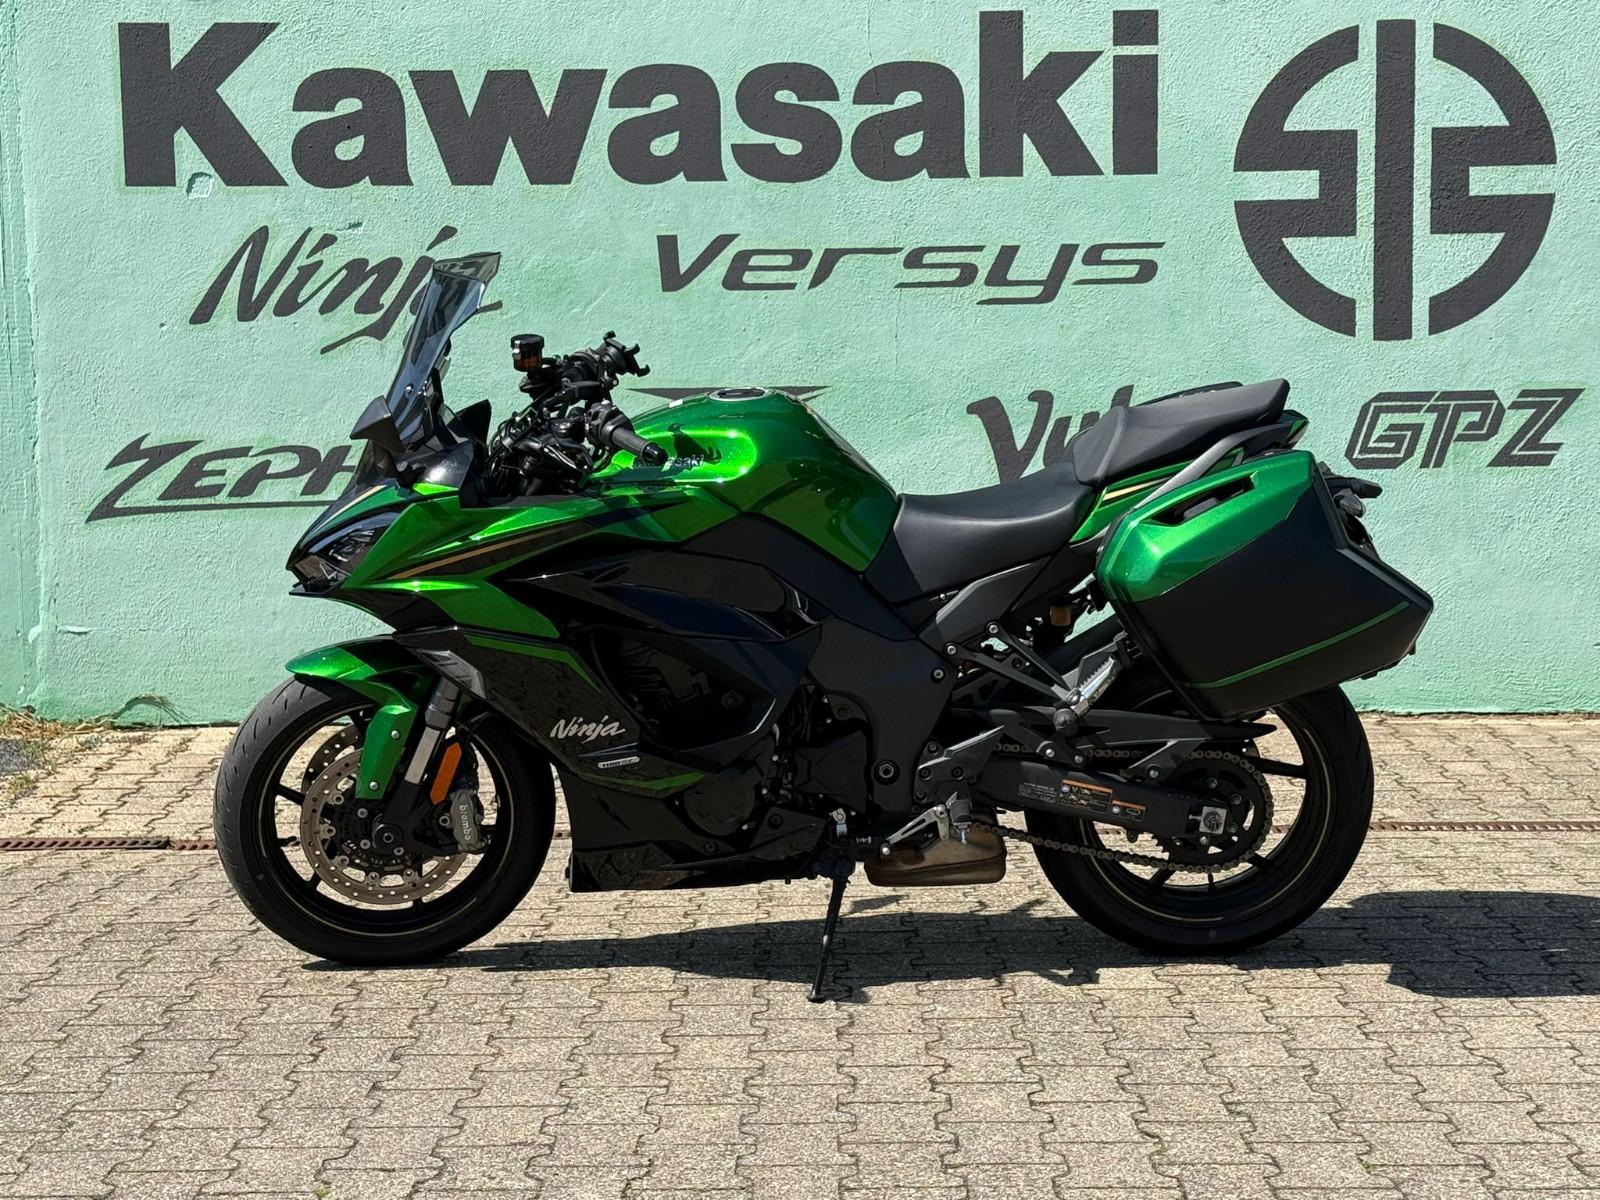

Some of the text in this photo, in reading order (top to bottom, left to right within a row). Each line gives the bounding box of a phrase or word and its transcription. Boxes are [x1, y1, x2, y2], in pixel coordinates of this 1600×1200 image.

[118, 9, 1158, 189] Kawasaki
[656, 233, 1165, 305] Versys
[1344, 388, 1586, 470] GPZ
[85, 433, 356, 523] ZEPH
[549, 715, 626, 744] Ninja
